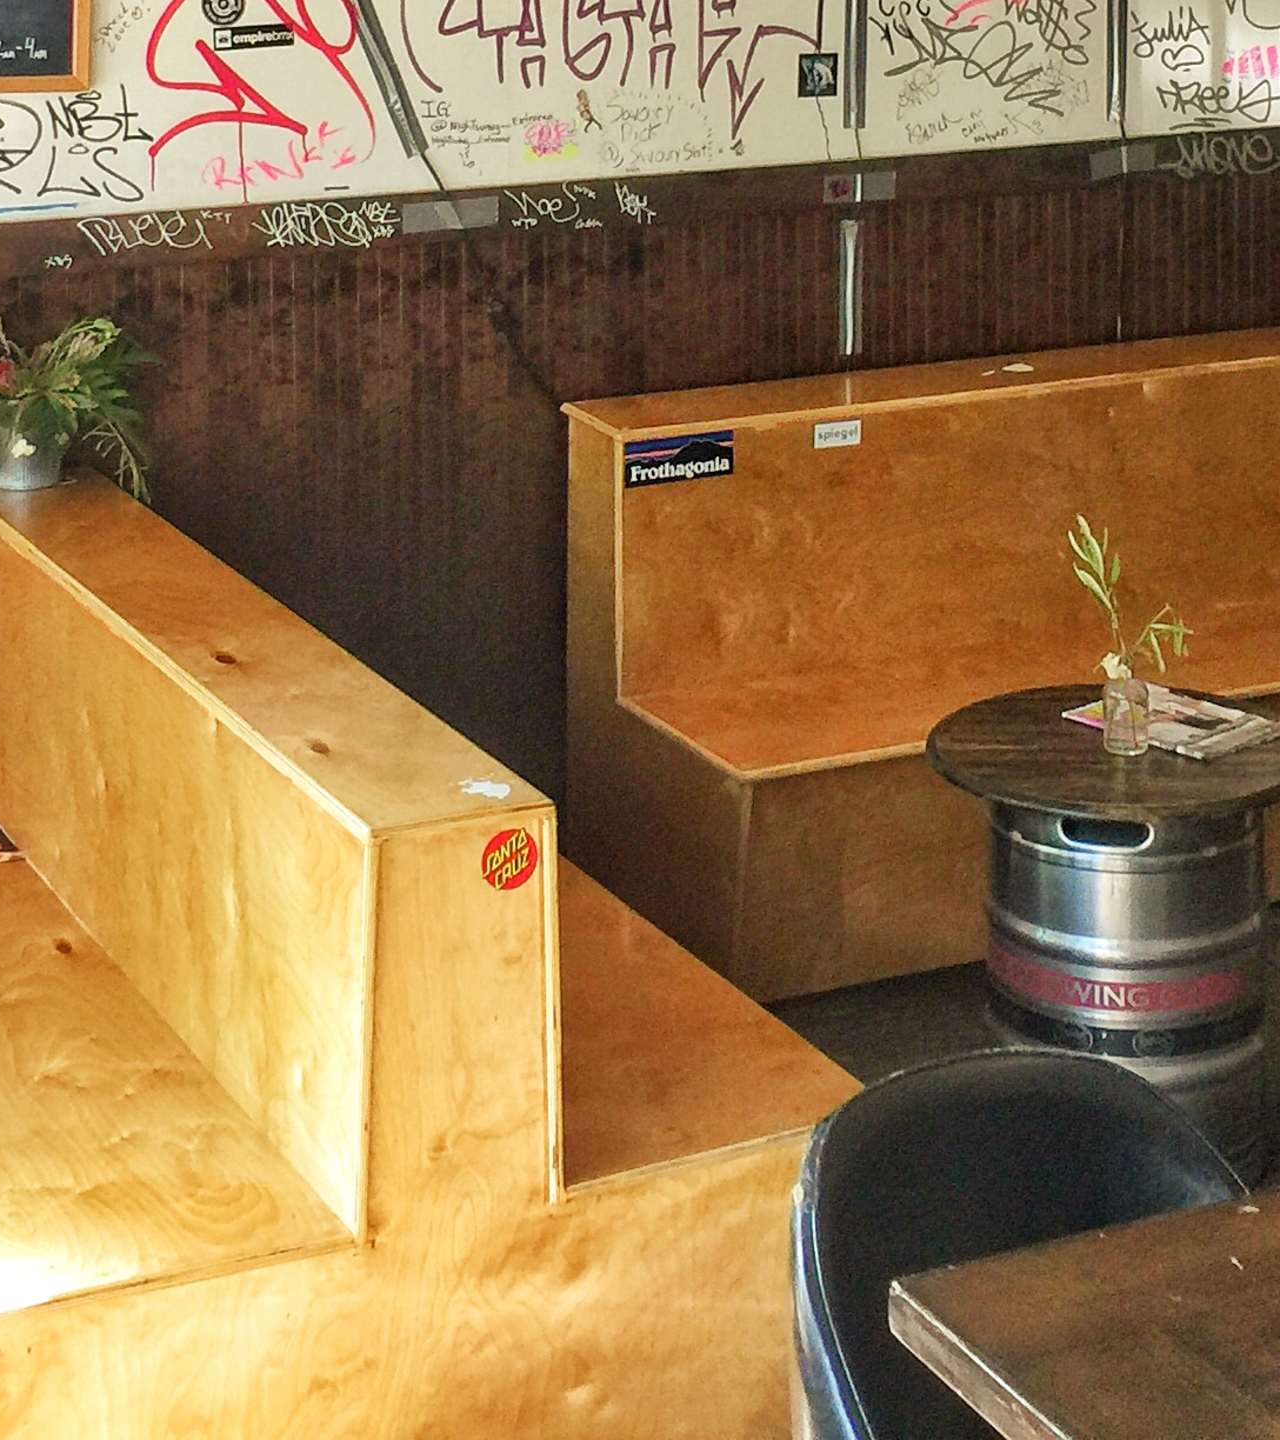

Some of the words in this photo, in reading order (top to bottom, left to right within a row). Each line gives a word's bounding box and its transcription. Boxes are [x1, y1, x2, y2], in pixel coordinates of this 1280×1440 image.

[818, 424, 859, 441] spiegel
[630, 456, 730, 483] Frothagonia
[483, 827, 528, 878] SANTA
[495, 846, 530, 890] CRUZ
